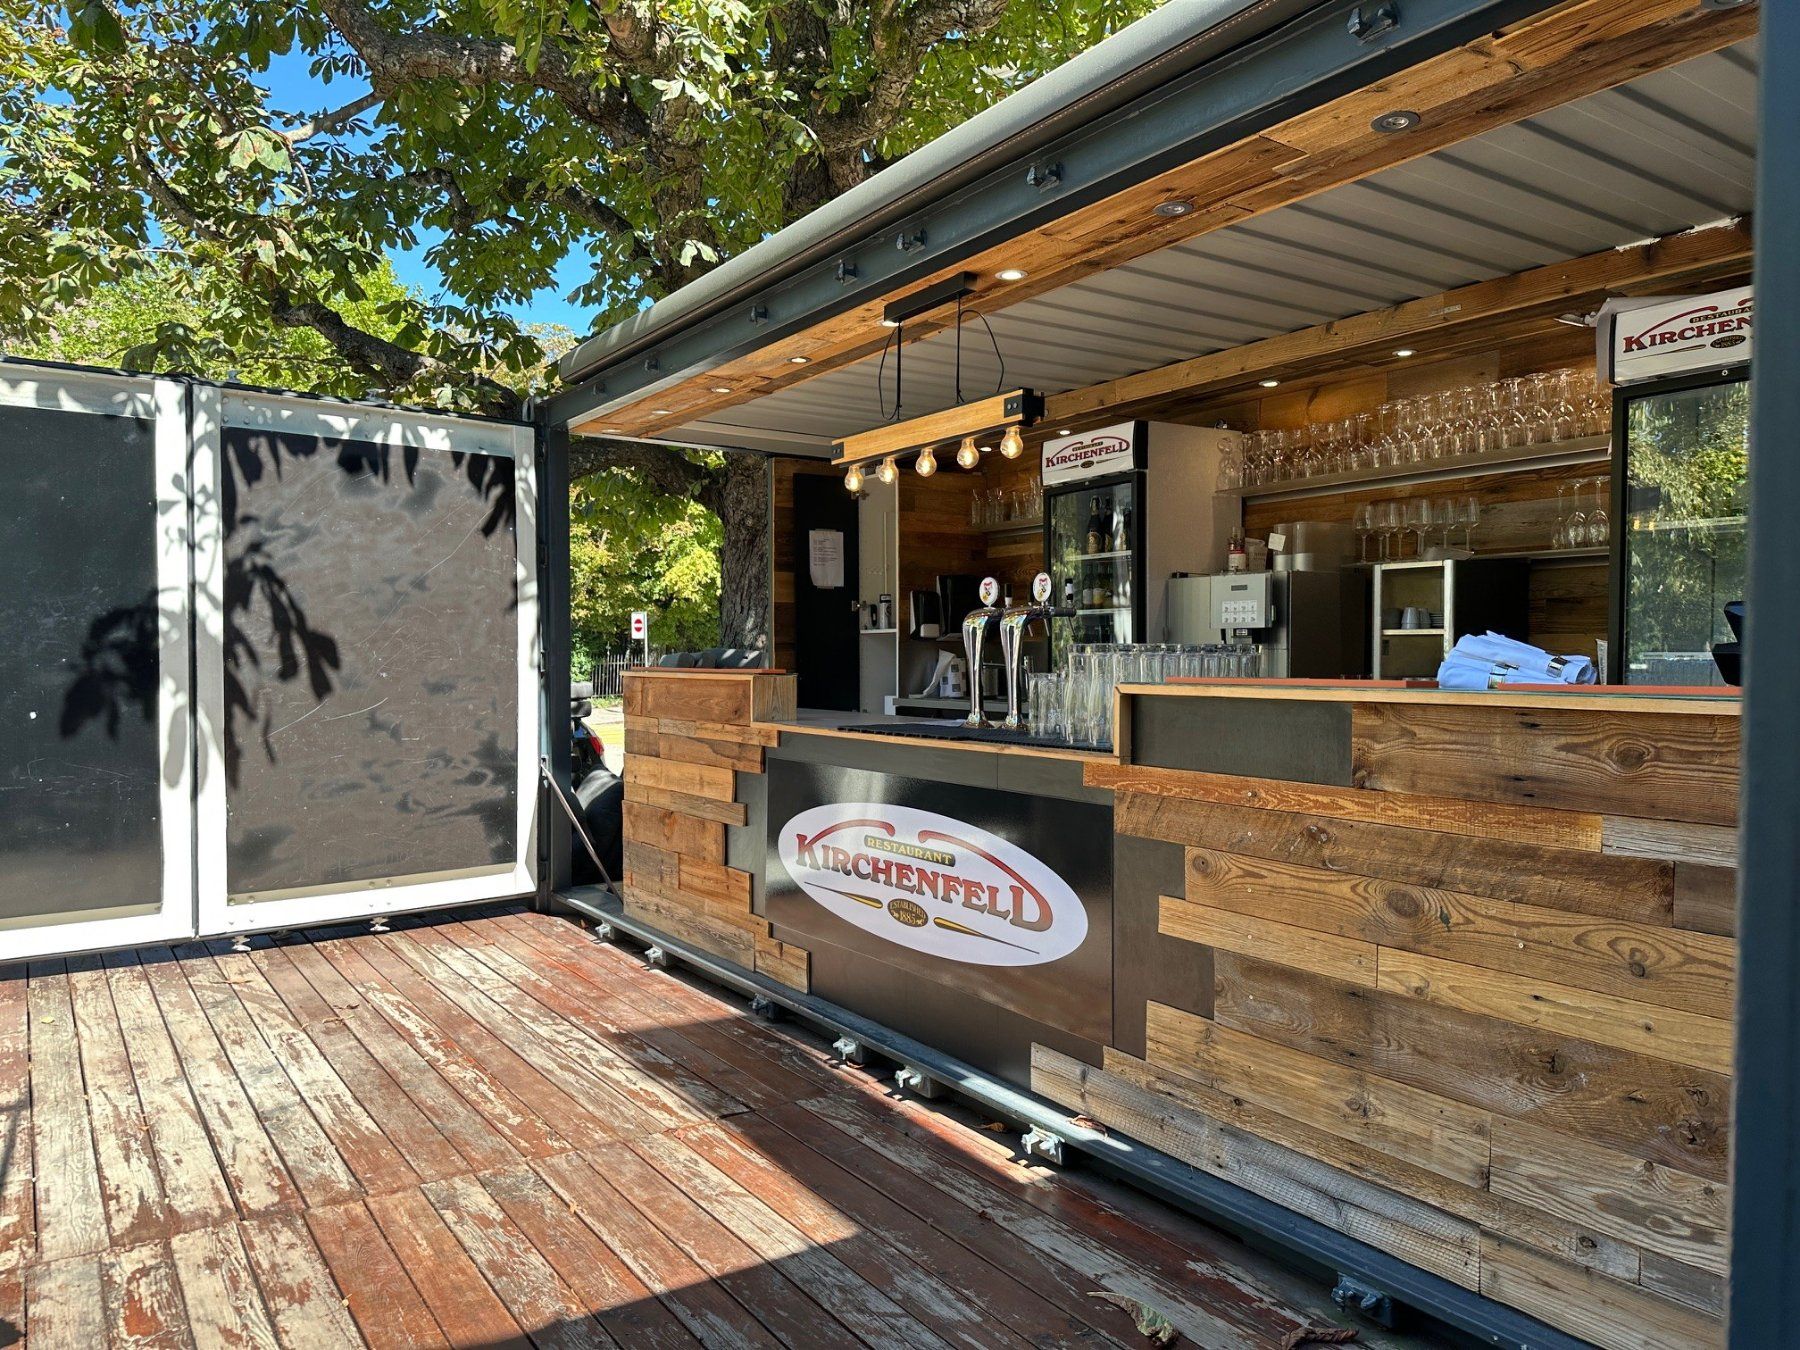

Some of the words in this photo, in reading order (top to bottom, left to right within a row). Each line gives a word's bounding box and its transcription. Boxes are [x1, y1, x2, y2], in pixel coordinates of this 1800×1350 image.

[1692, 306, 1752, 323] RESTAURA
[1045, 439, 1131, 468] KIRCHENFELD
[867, 837, 953, 865] RESTAURANT
[796, 832, 1054, 932] KIRCHENFELD
[890, 900, 927, 920] ESTABLISHED
[899, 910, 916, 925] 1885
